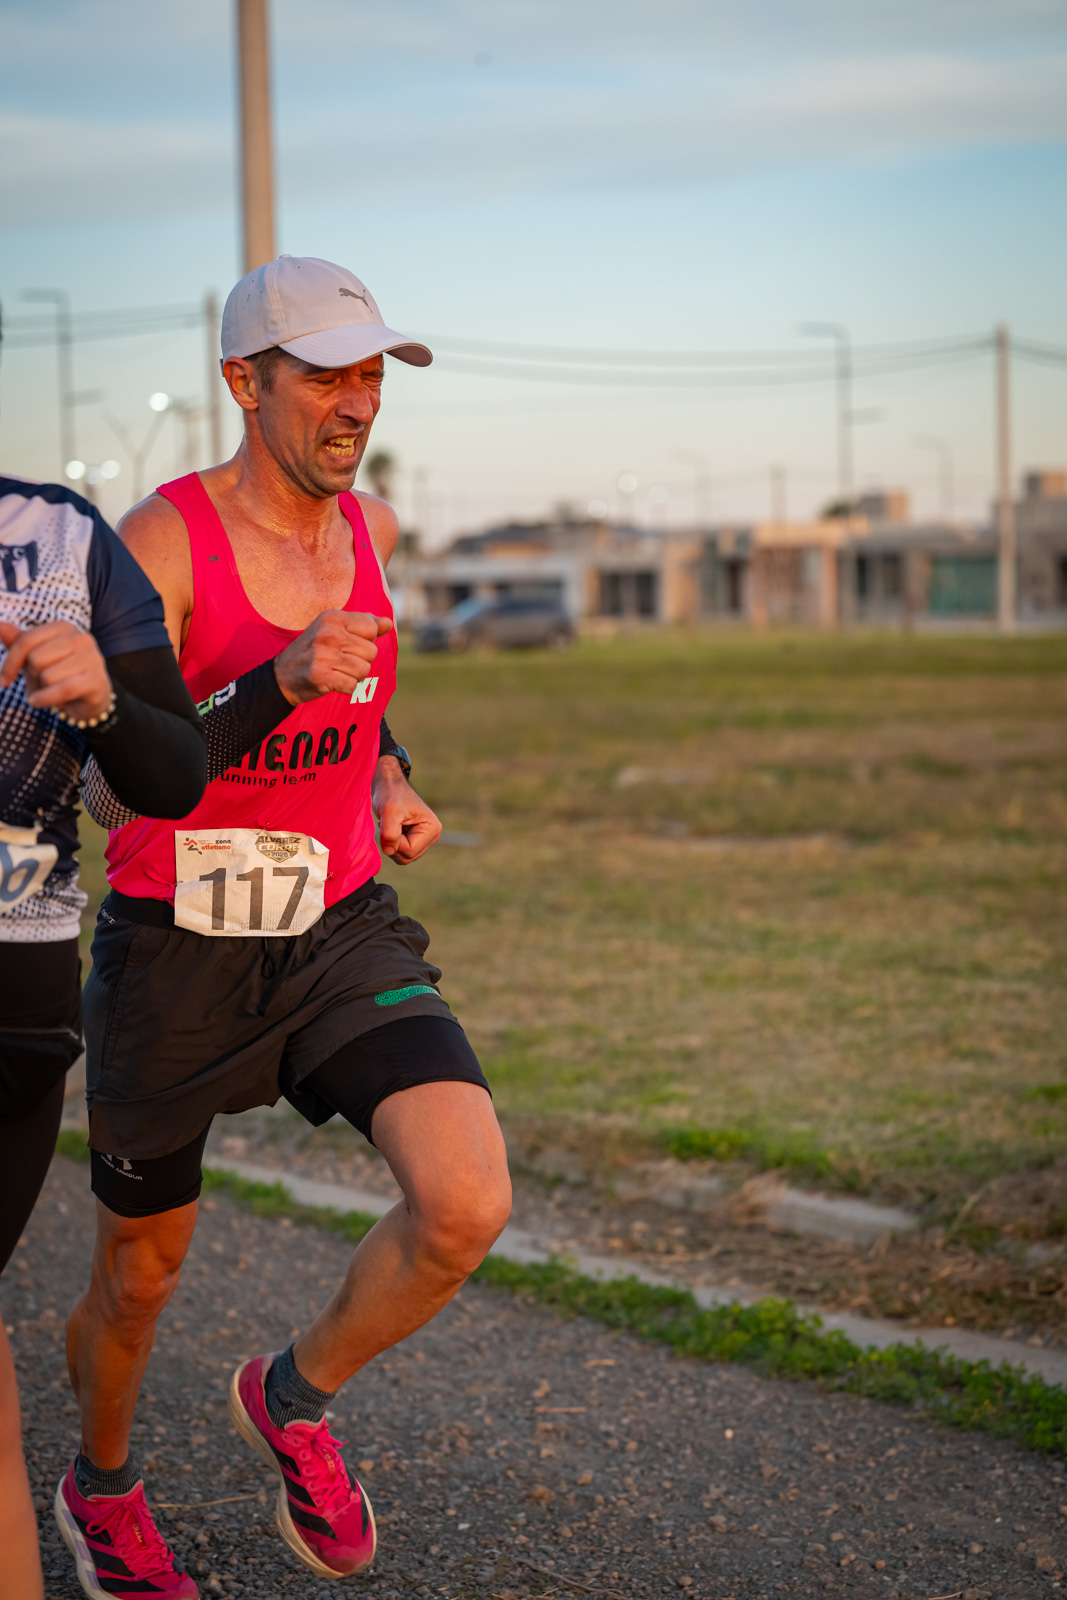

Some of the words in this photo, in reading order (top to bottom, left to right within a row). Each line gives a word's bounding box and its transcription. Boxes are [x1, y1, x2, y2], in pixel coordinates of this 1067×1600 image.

[221, 773, 277, 788] unning
[255, 836, 302, 844] ALVAREZ
[199, 867, 309, 930] 117
